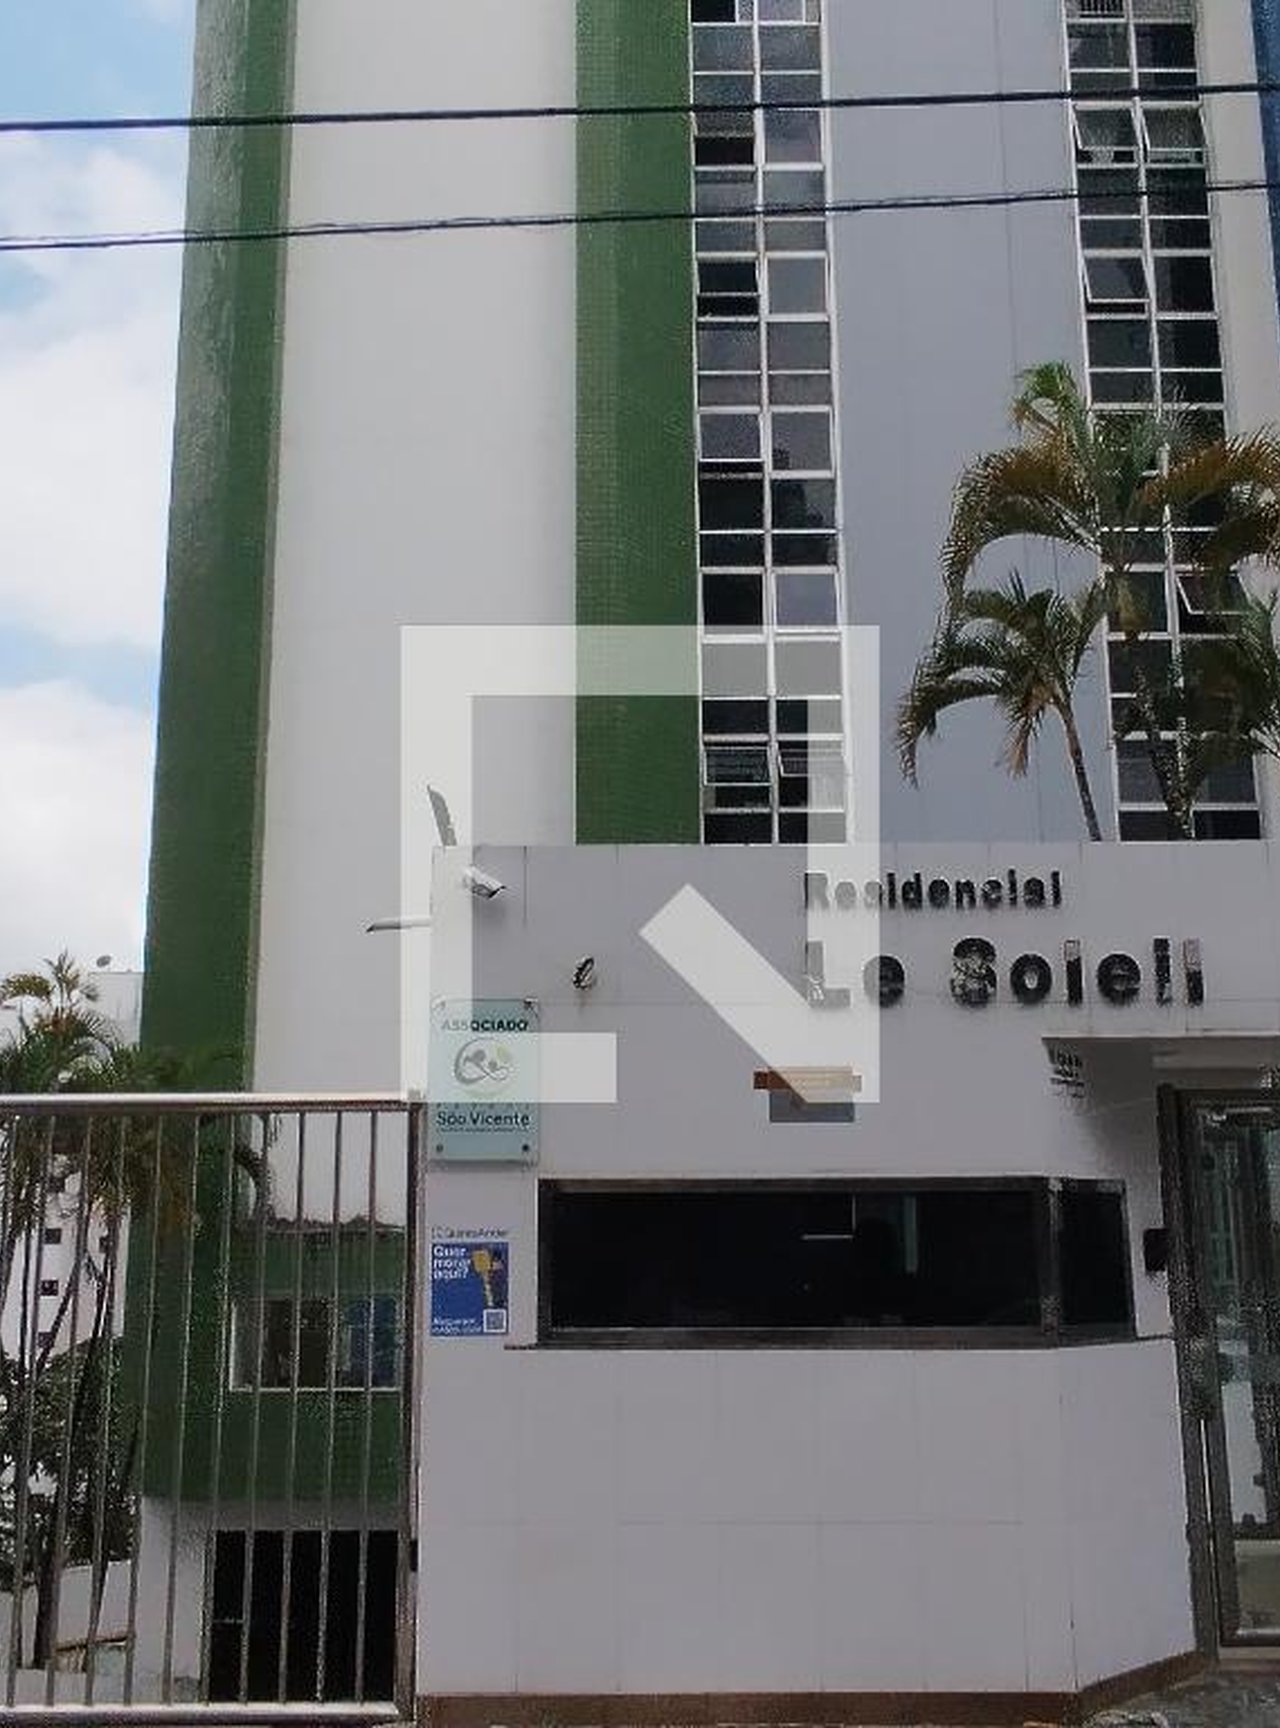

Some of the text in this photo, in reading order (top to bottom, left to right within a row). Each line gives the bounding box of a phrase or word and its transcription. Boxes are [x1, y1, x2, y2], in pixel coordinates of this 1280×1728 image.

[804, 869, 1061, 909] Residencial
[805, 937, 1205, 1008] Le Soleil
[441, 1020, 529, 1031] ASSOCIADO
[469, 1111, 530, 1126] Vicente
